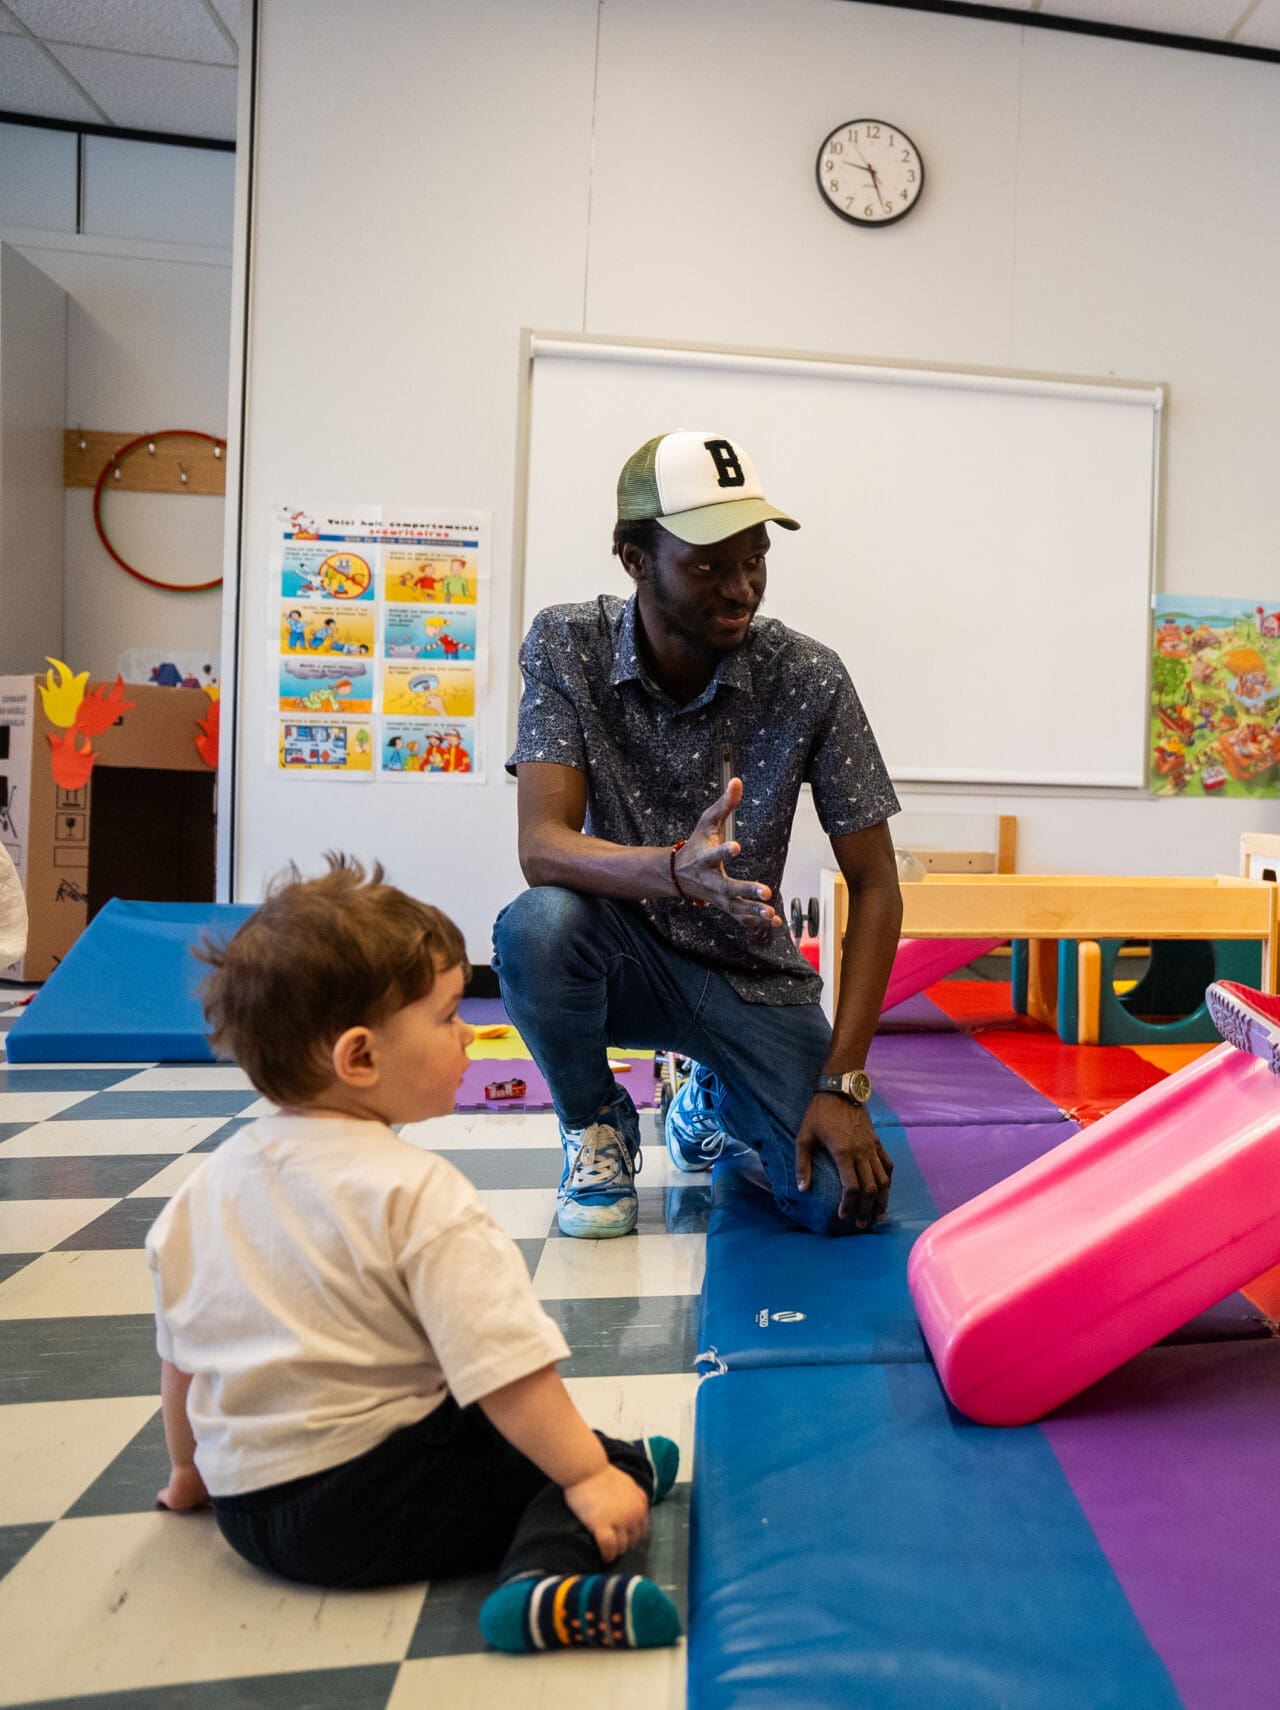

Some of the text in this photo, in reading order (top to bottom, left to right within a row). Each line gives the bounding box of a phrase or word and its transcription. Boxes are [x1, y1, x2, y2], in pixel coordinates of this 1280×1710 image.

[848, 129, 858, 143] 11
[866, 125, 881, 139] 12
[889, 134, 894, 147] 1
[829, 141, 843, 155] 10
[901, 149, 910, 163] 2
[825, 160, 834, 173] 9
[906, 169, 916, 183] 3
[829, 179, 839, 192] 8
[900, 187, 908, 200] 4
[845, 196, 855, 210] 7
[863, 203, 873, 217] 6
[883, 200, 893, 214] 5
[704, 439, 745, 488] B
